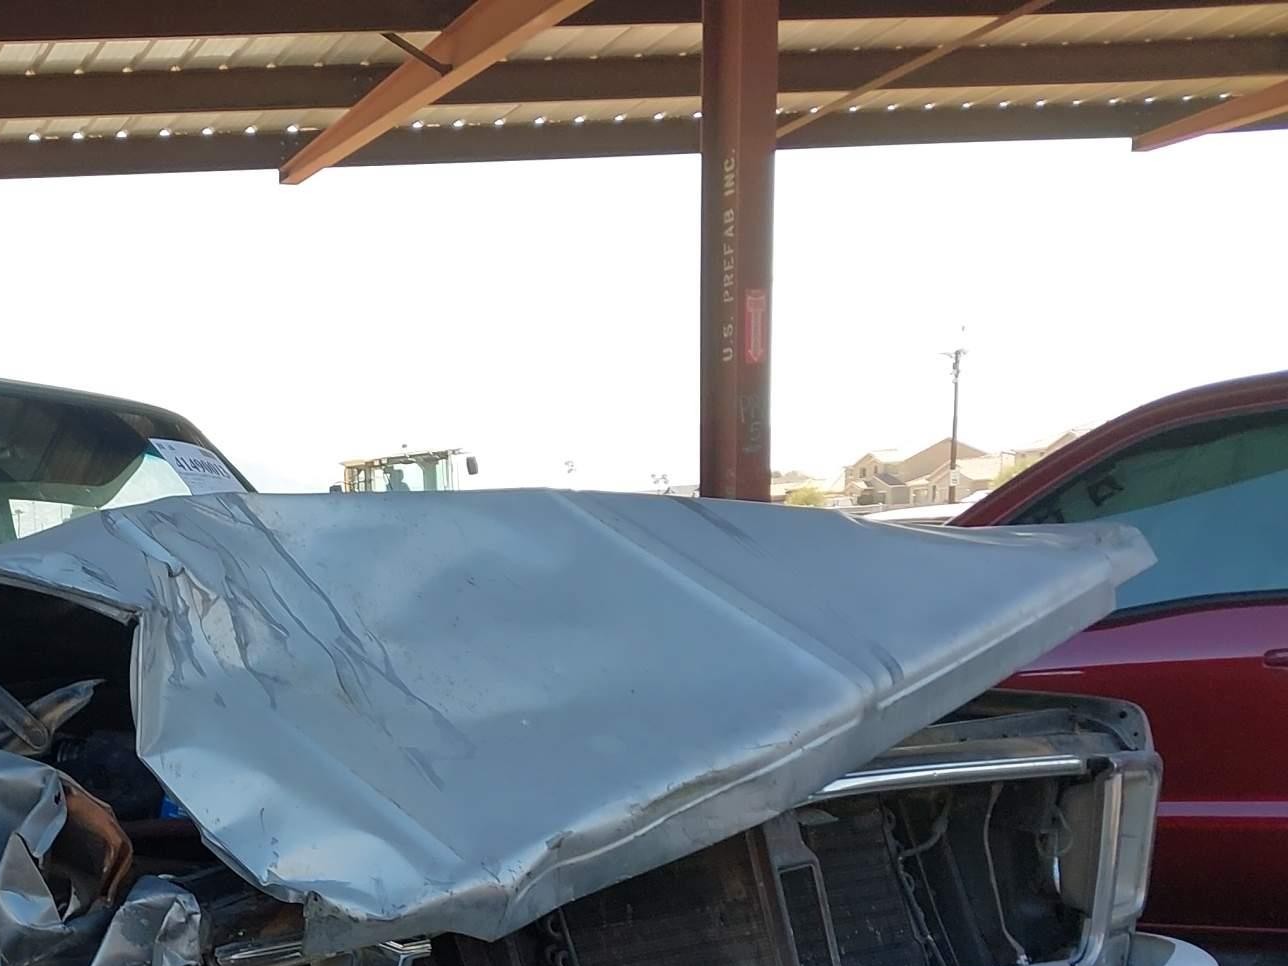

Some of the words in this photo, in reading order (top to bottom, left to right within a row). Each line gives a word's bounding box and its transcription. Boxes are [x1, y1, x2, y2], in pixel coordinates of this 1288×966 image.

[722, 147, 736, 197] INC.
[722, 206, 735, 304] PREFAB
[721, 315, 735, 363] U.S.
